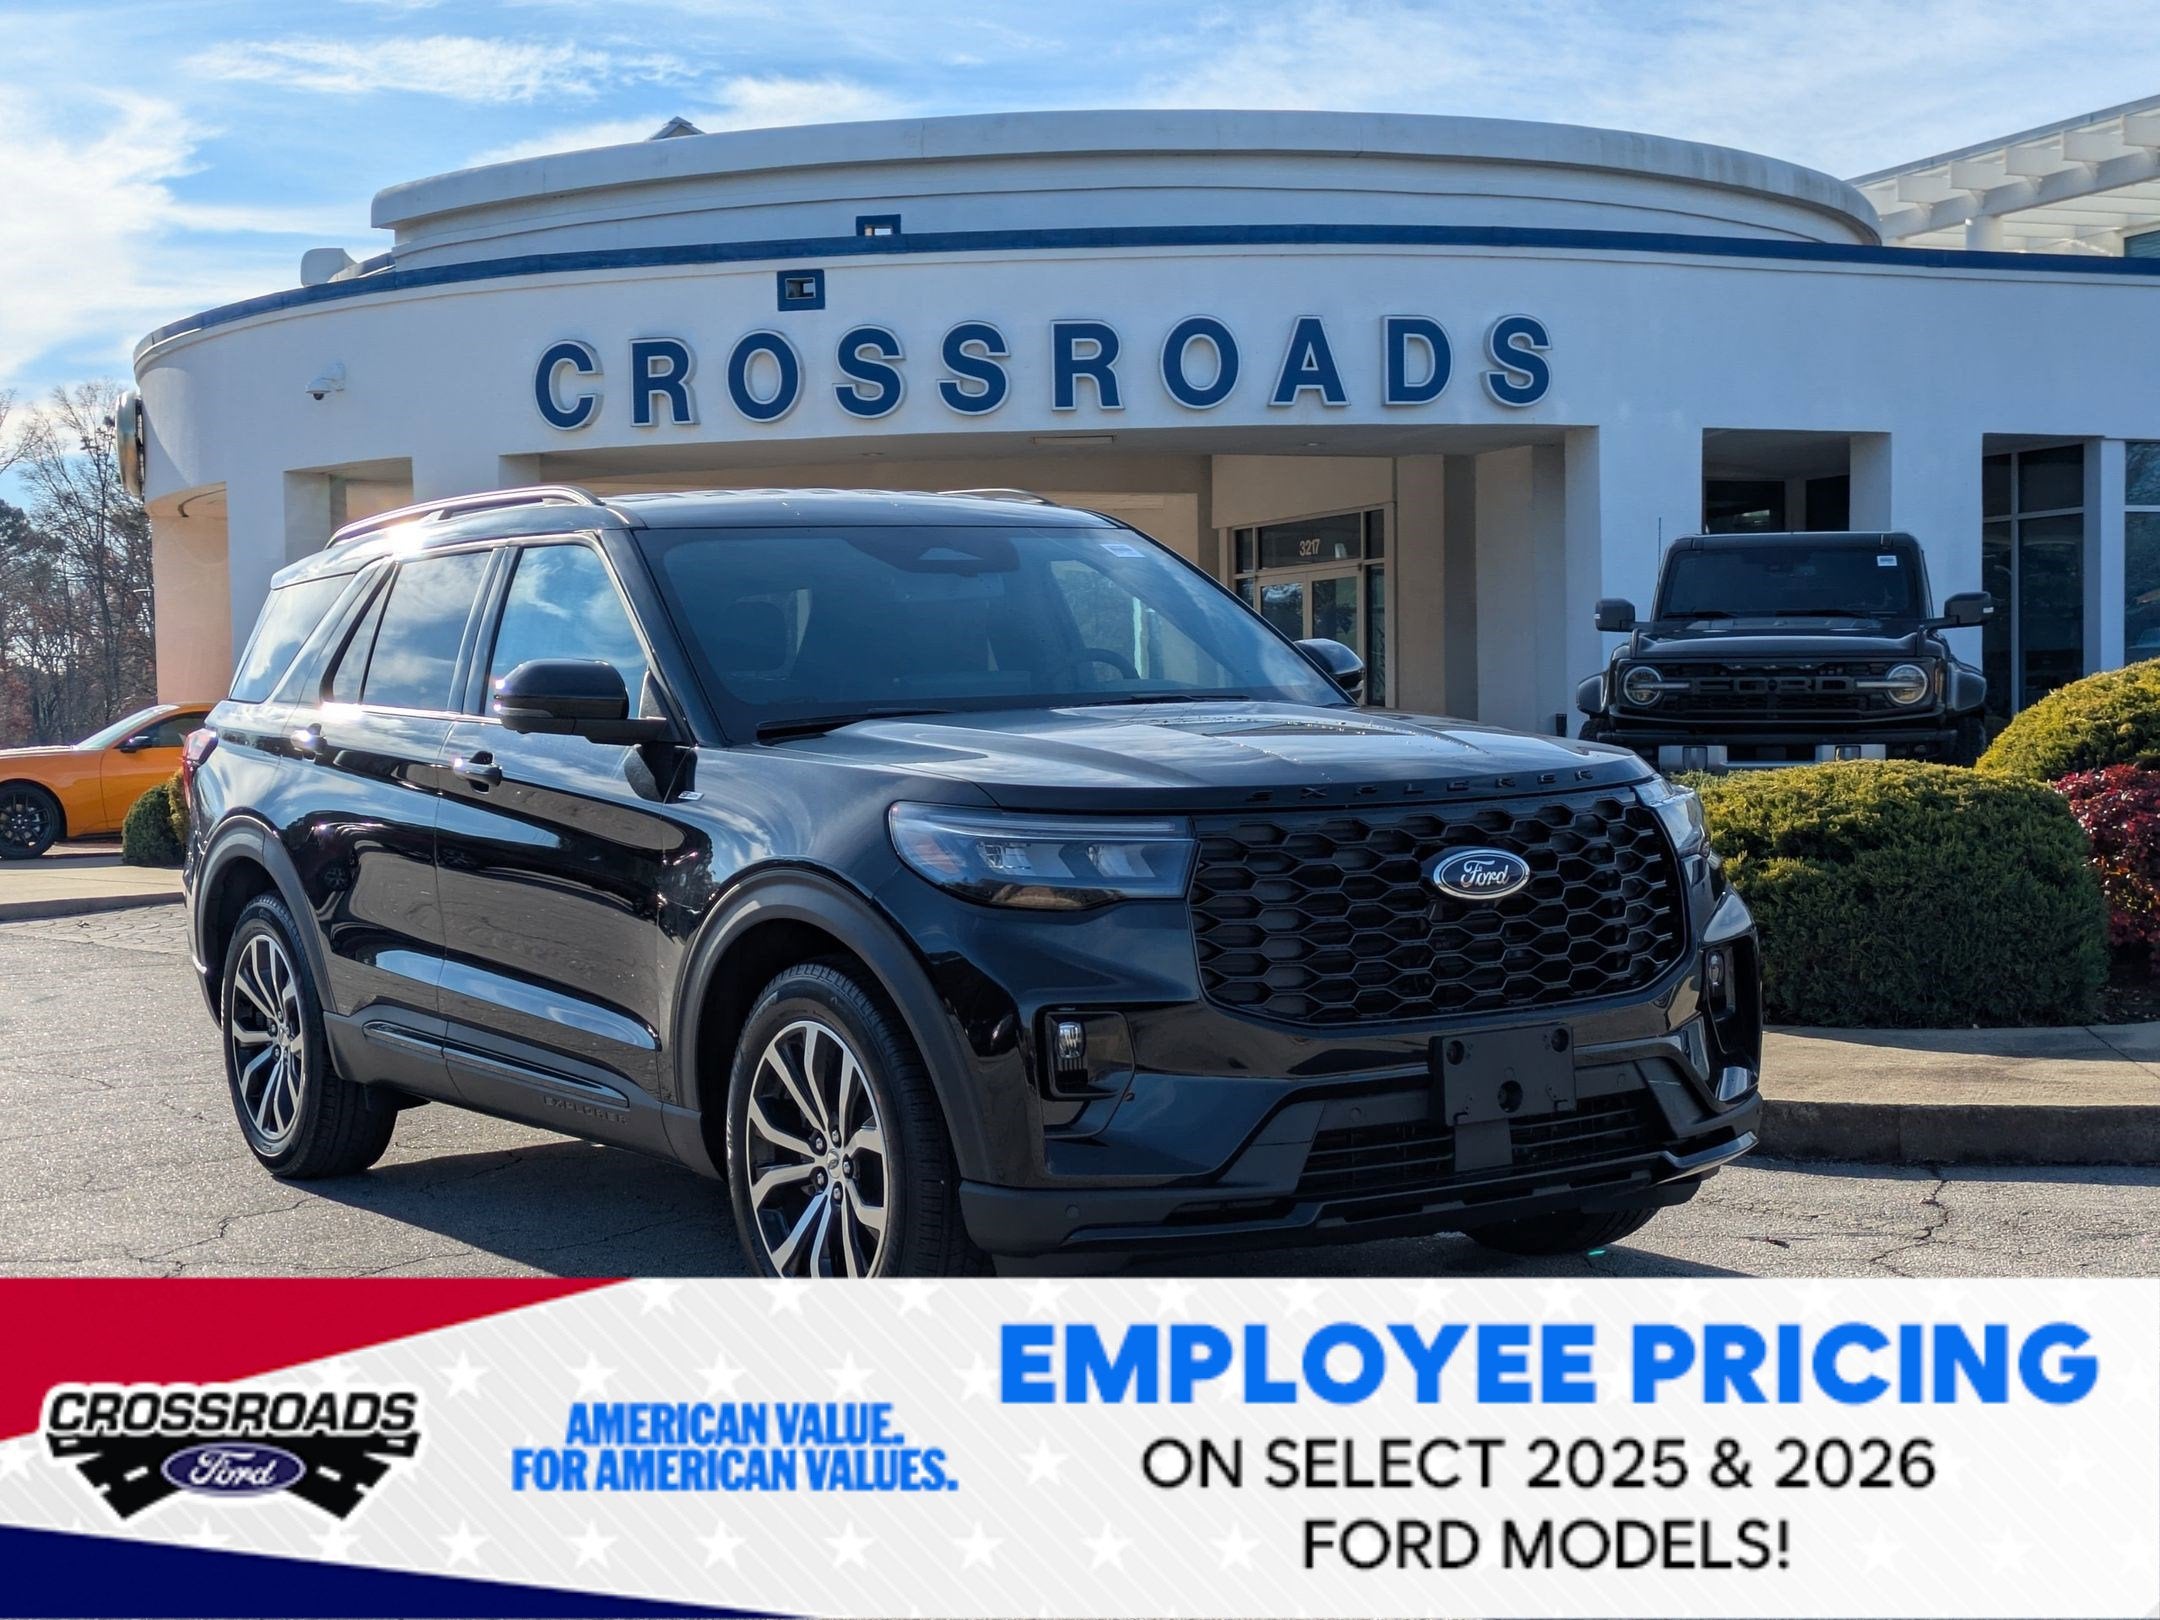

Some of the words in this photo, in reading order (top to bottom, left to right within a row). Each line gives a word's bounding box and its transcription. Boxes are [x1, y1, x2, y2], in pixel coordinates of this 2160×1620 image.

[533, 313, 1554, 431] CROSSROADS
[1299, 538, 1321, 556] 3217
[1246, 767, 1593, 802] EXPLORER
[1460, 860, 1509, 888] Ford
[543, 1095, 629, 1126] EXPLORER
